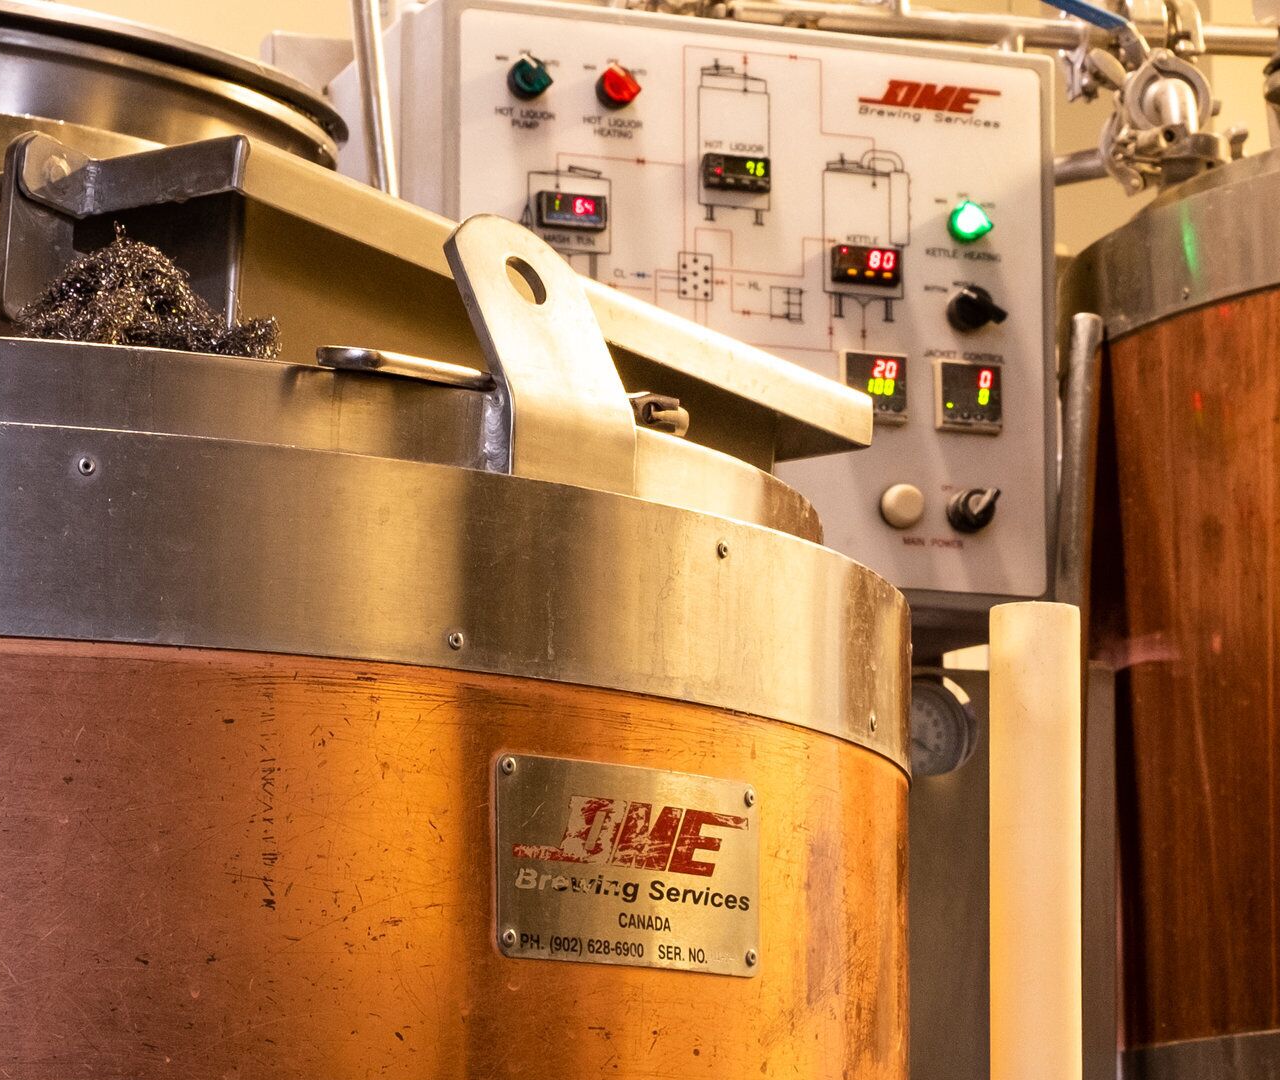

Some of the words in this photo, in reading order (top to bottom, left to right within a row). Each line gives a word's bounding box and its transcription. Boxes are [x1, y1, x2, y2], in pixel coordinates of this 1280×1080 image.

[858, 79, 1002, 115] DME
[495, 106, 515, 117] HOT
[520, 108, 556, 121] LIQUOR
[858, 104, 922, 122] Brewing
[934, 112, 1001, 129] Services
[512, 118, 540, 129] PUMP
[583, 116, 602, 125] HOT
[608, 118, 643, 129] LIQUOR
[593, 128, 633, 139] HEATING
[704, 140, 723, 149] HOT
[729, 142, 764, 153] LIQUOR
[847, 234, 878, 245] KETTLE
[869, 250, 895, 270] 80
[925, 247, 959, 260] KETTLE
[613, 268, 627, 280] CL
[748, 280, 762, 292] HL
[872, 359, 898, 379] 20
[979, 370, 992, 389] 0
[512, 795, 749, 877] DME
[514, 868, 639, 903] Brewing
[649, 880, 750, 911] Services
[618, 912, 671, 932] CANADA
[520, 933, 544, 950] PH.
[549, 935, 583, 956] (902)
[587, 938, 644, 958] 628-6900
[658, 944, 685, 962] SER.
[689, 948, 708, 964] NO.
